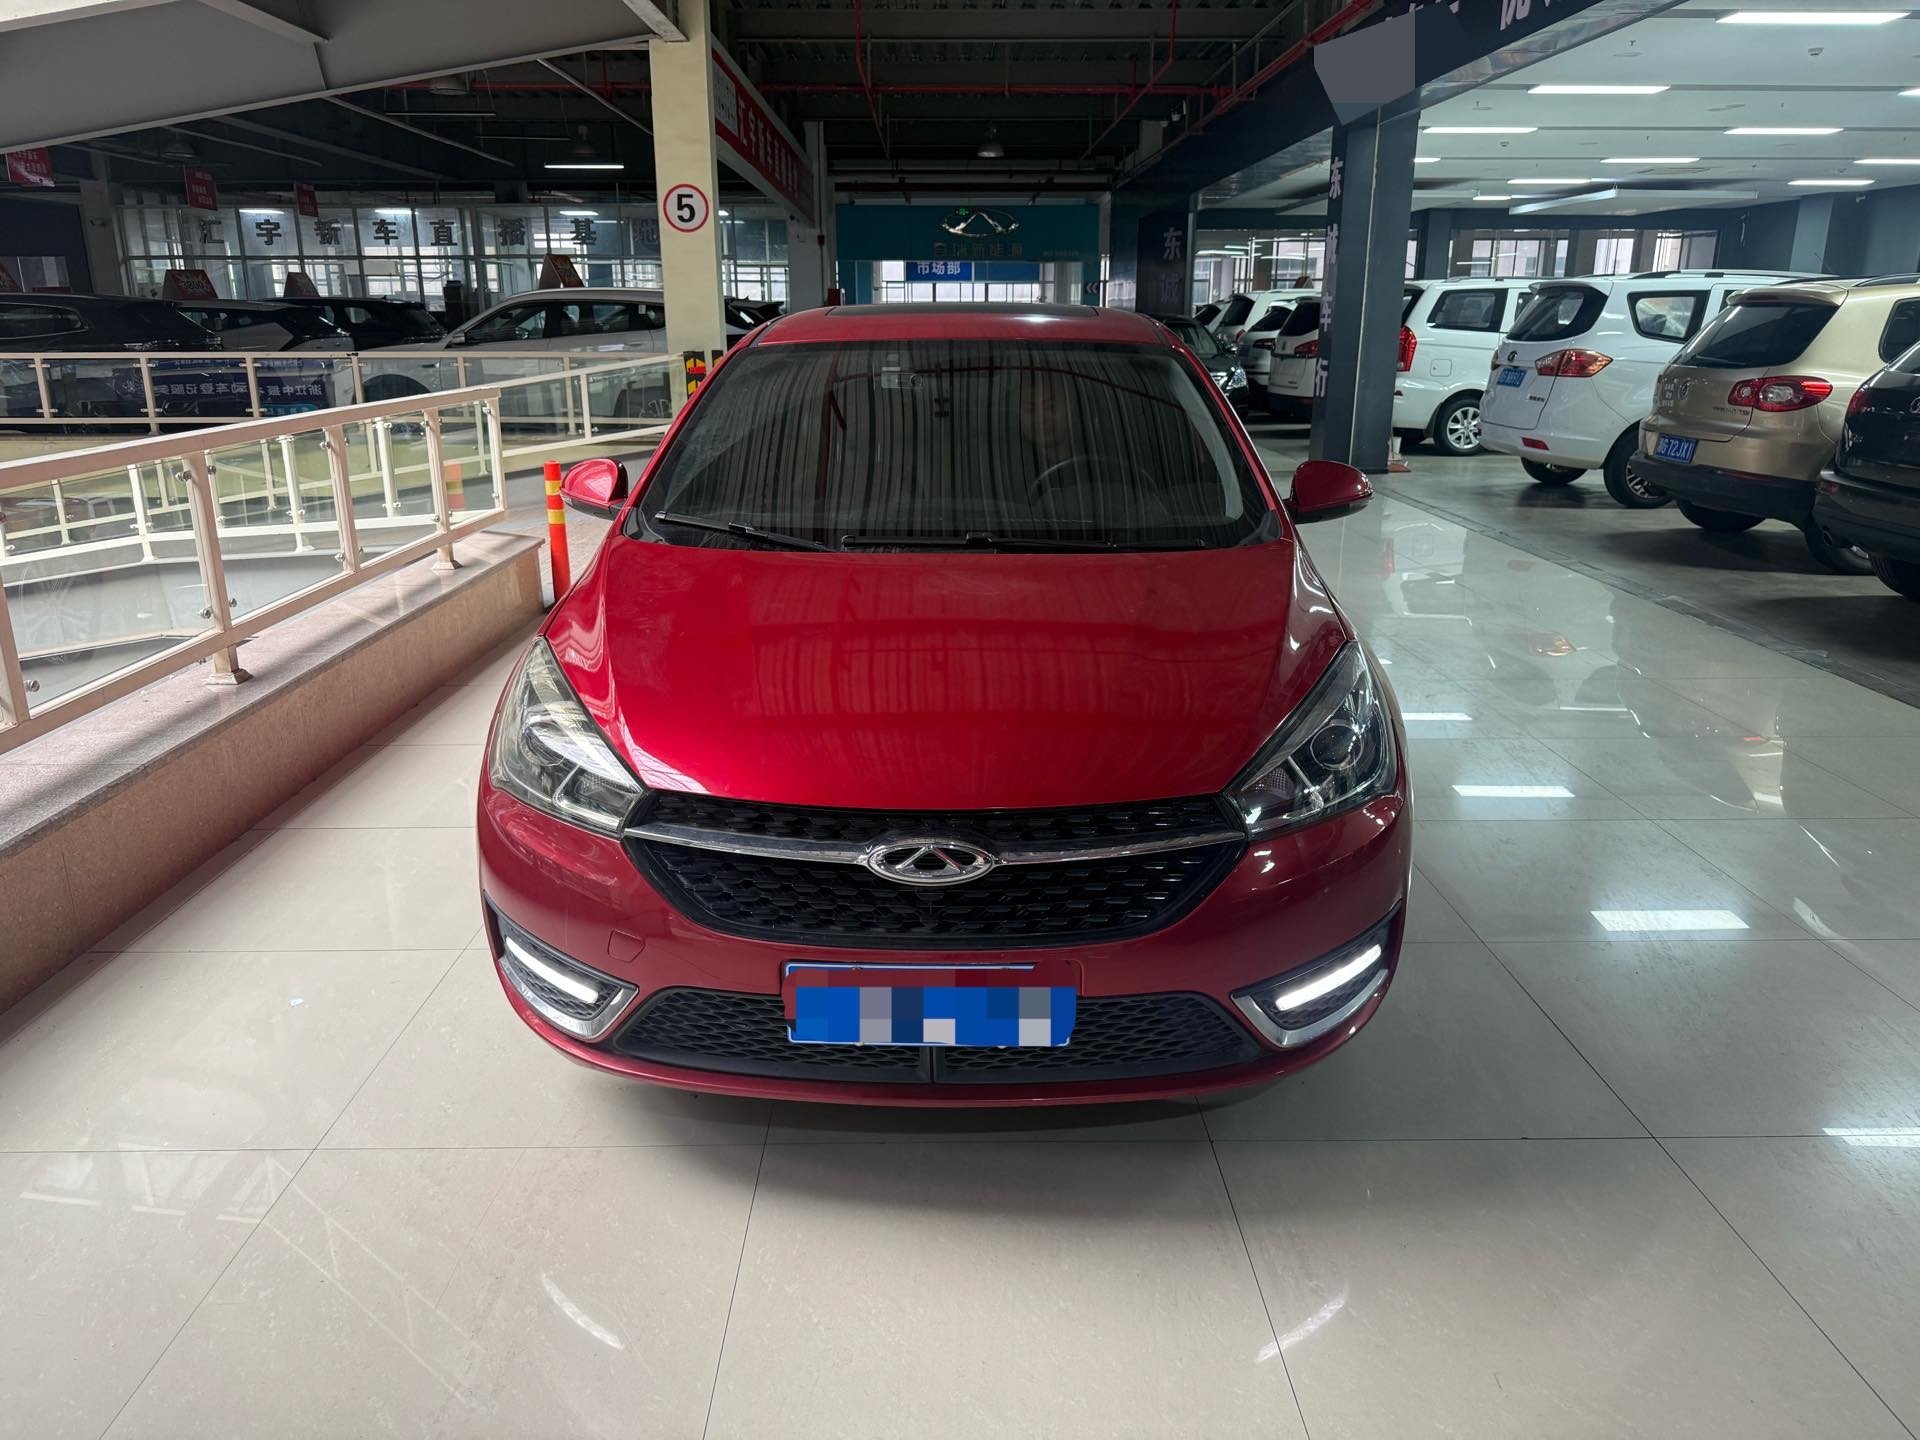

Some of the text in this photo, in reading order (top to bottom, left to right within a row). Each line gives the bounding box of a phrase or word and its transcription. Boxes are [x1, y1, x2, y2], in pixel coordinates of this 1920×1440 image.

[677, 193, 696, 223] 5
[917, 260, 961, 275] 市场部
